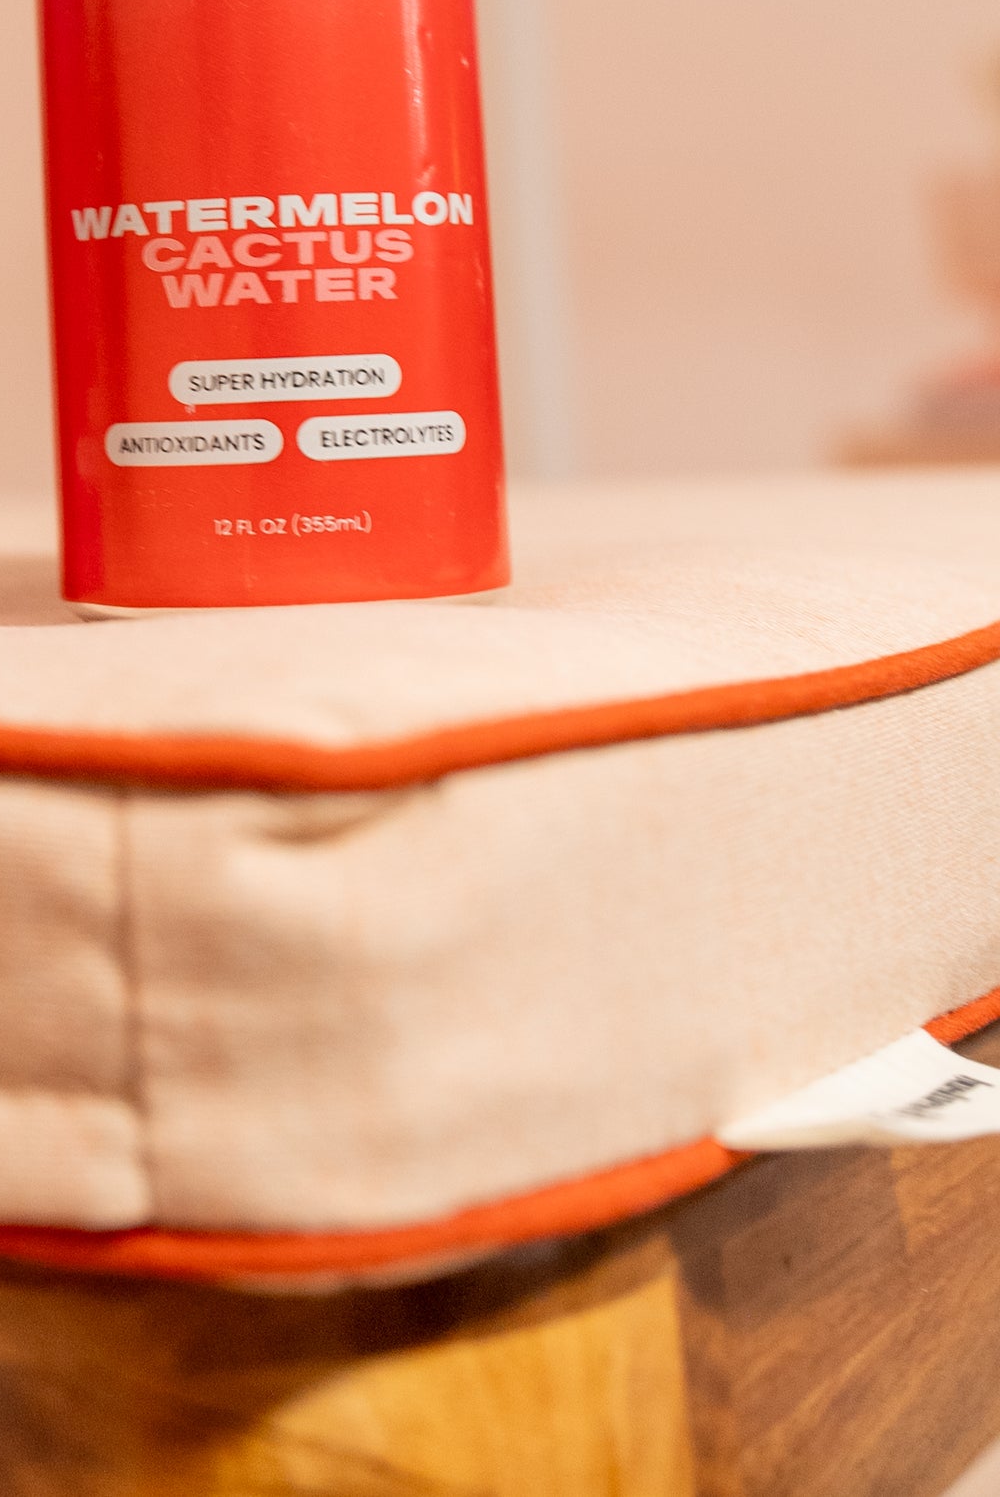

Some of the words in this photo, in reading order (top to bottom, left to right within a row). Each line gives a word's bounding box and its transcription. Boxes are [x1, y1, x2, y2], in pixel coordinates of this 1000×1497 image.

[71, 191, 474, 241] WATERMELON
[141, 229, 413, 272] CACTUS
[161, 267, 398, 308] WATER
[188, 372, 255, 393] SUPER
[260, 366, 386, 390] HYDRATION
[119, 432, 266, 455] ANTIOXIDANTS
[320, 423, 456, 448] ELECTROLYTES
[213, 518, 234, 536] 12
[236, 518, 257, 536] FL
[259, 517, 288, 535] OZ
[291, 510, 373, 538] (355mL)
